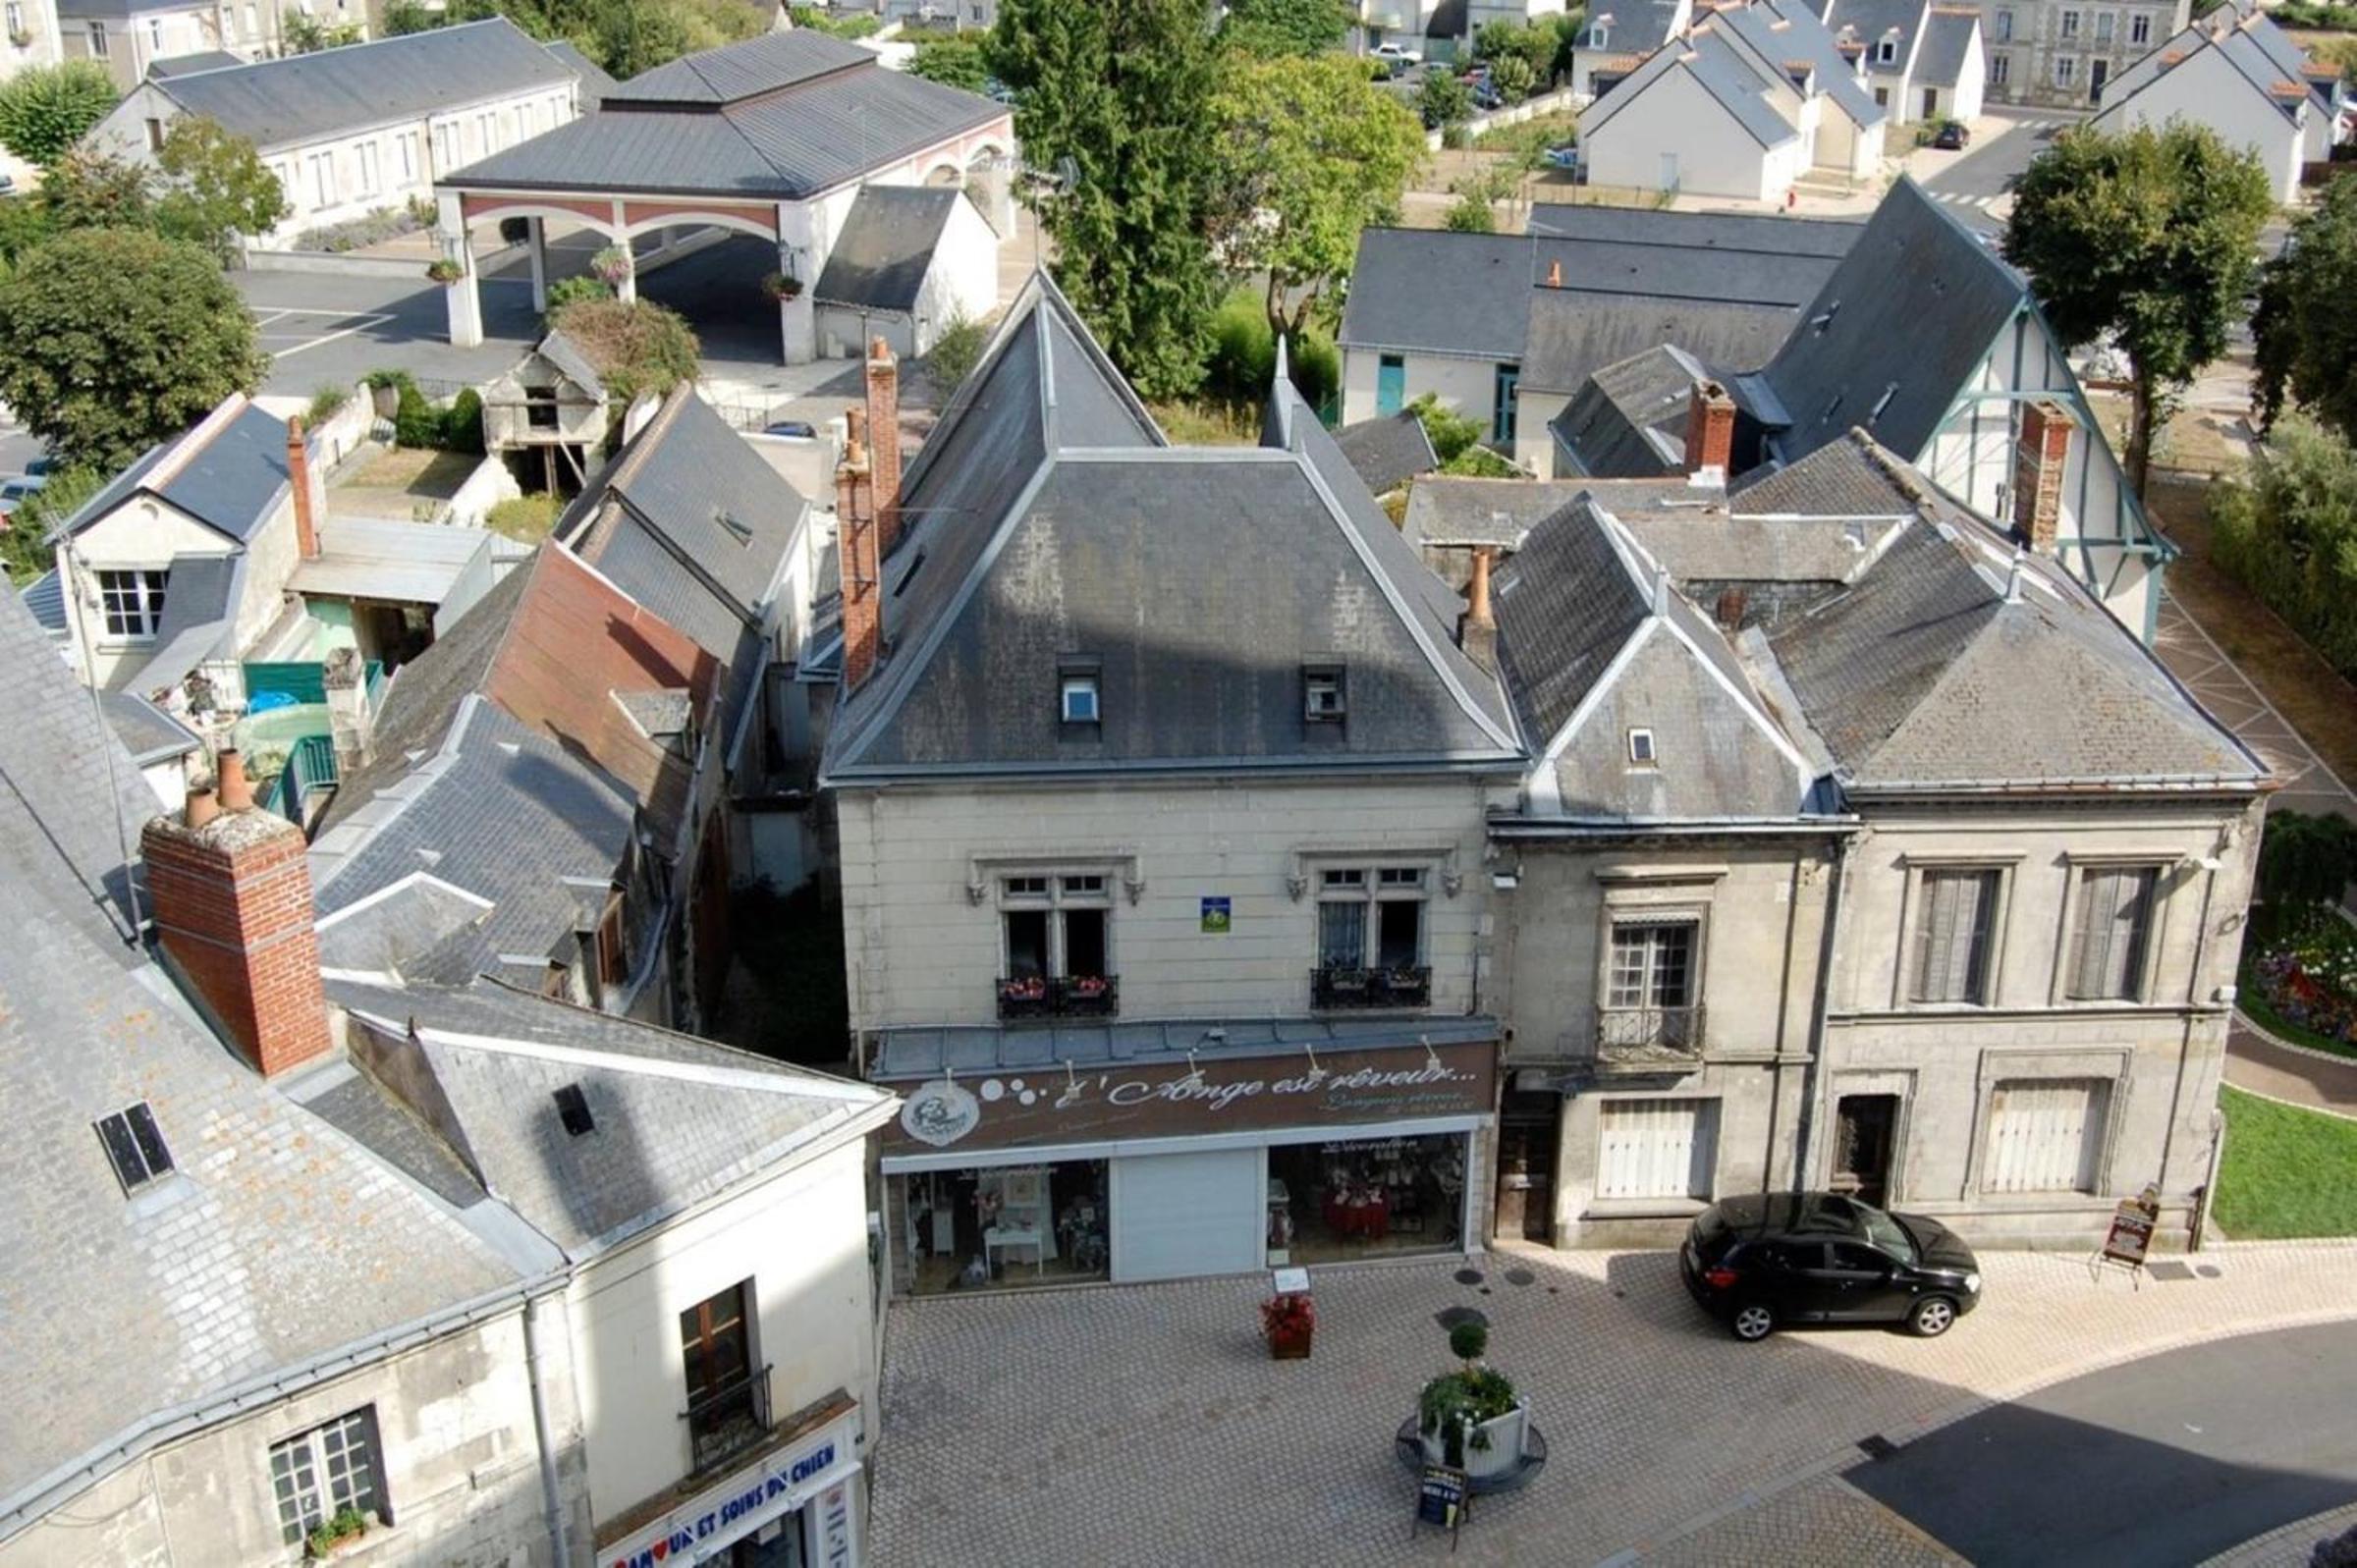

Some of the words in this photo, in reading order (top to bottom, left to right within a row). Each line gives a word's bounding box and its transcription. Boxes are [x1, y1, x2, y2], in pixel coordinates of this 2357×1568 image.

[1272, 1069, 1328, 1094] est
[697, 1514, 715, 1539] ET
[722, 1487, 764, 1525] SOINS
[793, 1445, 835, 1483] CHIEN
